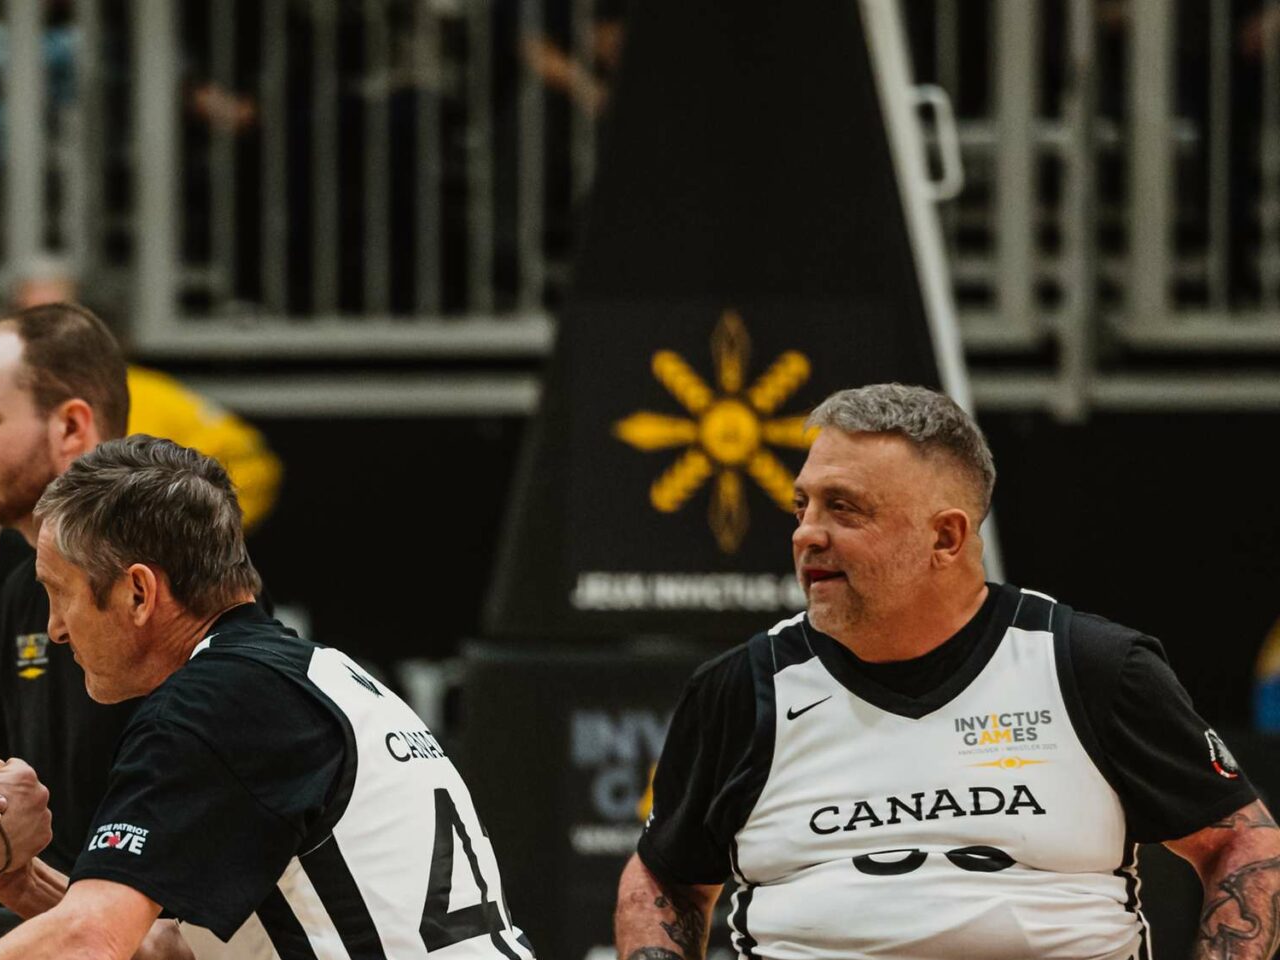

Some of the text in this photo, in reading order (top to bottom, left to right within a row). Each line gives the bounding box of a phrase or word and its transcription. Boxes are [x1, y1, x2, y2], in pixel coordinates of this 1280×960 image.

[954, 709, 1052, 732] INVICTUS
[384, 731, 448, 763] CANA
[963, 727, 1038, 746] GAMES
[808, 784, 1047, 835] CANADA
[112, 822, 150, 838] PATRIOT
[87, 830, 146, 856] LOVE
